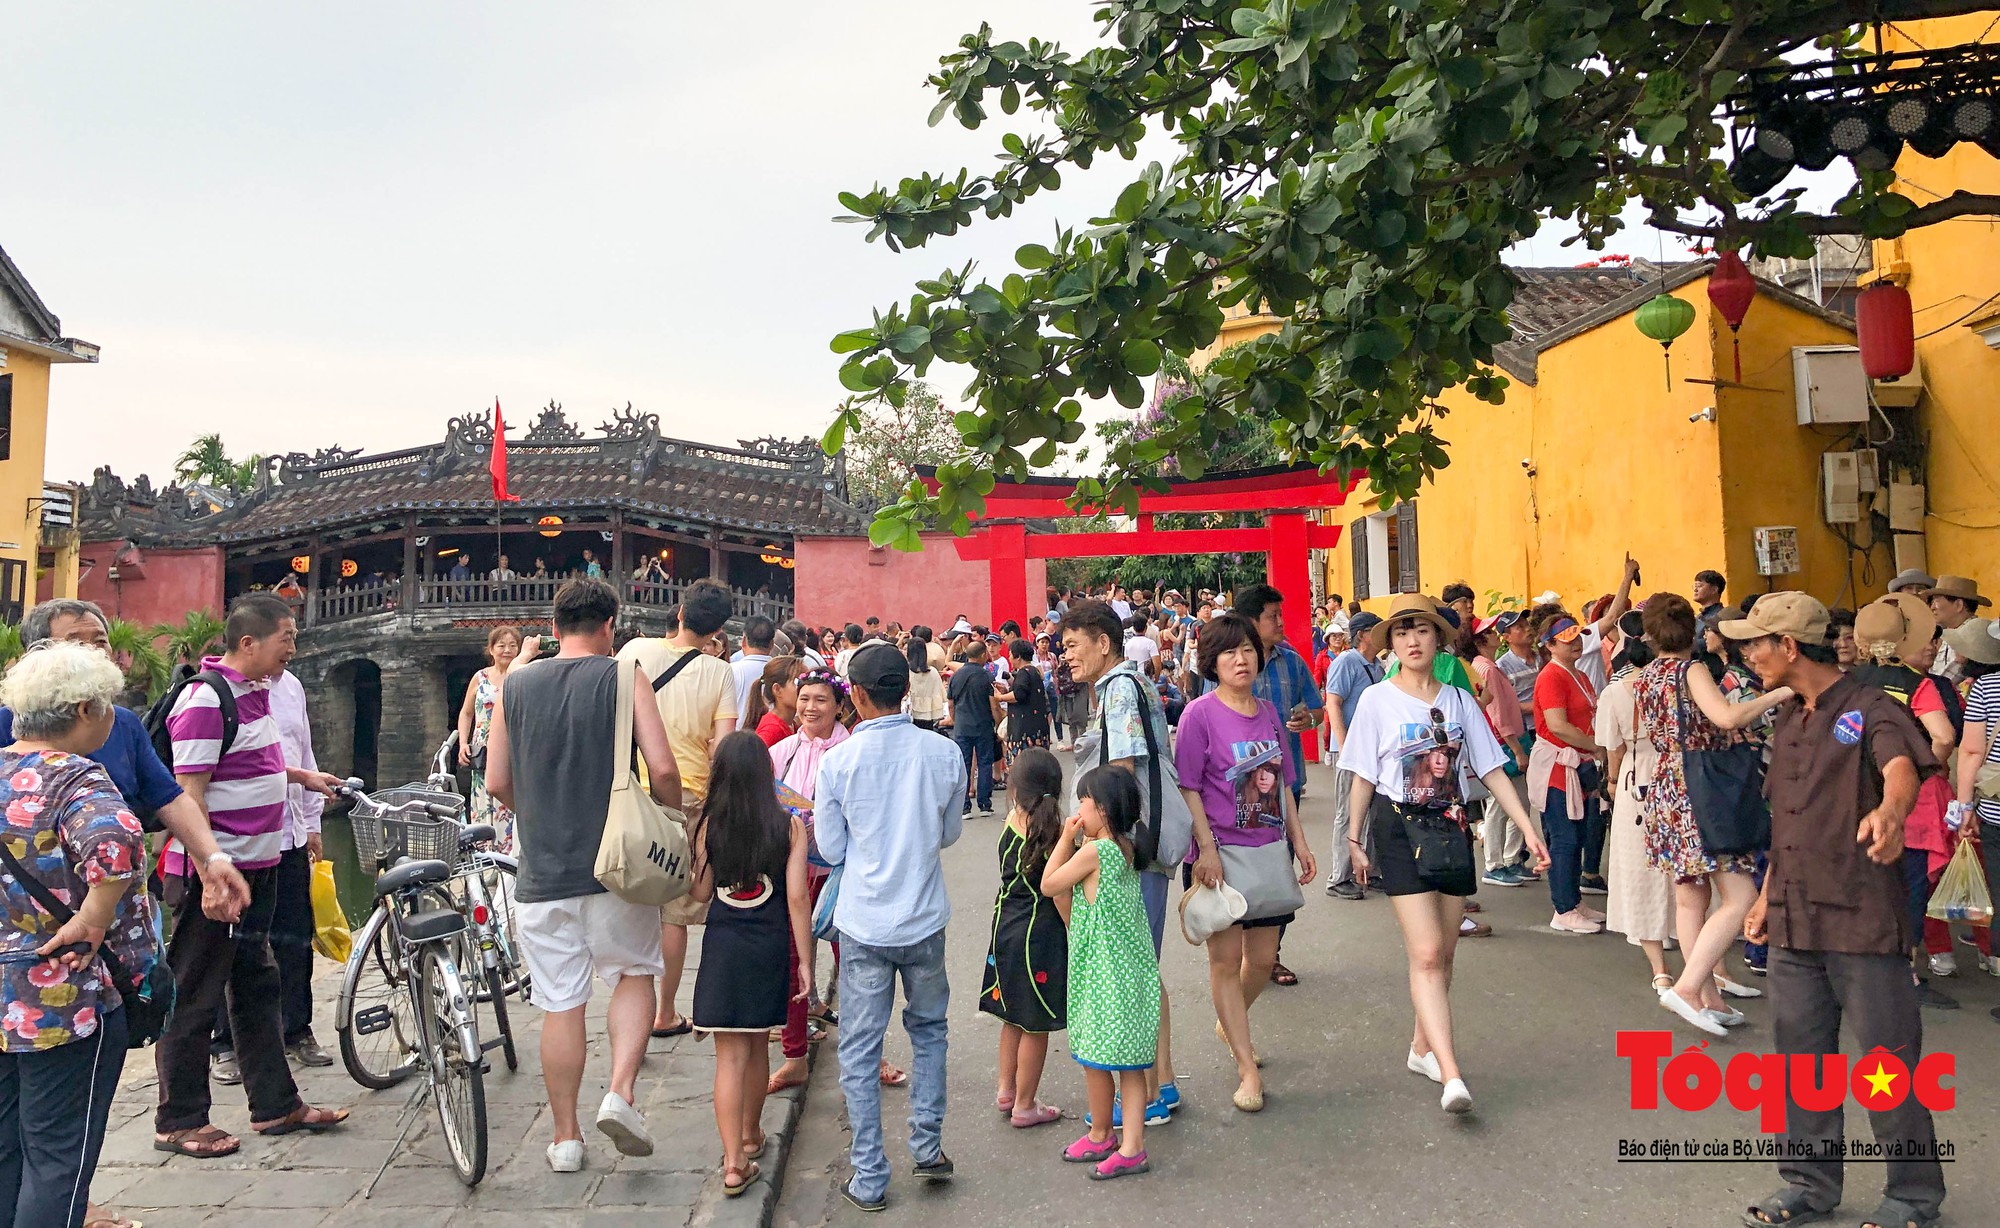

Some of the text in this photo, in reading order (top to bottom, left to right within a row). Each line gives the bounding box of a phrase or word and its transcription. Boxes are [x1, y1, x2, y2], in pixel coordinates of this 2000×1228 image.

[1404, 787, 1435, 797] LOVE
[1236, 803, 1262, 812] LOVE
[1236, 811, 1250, 820] ME
